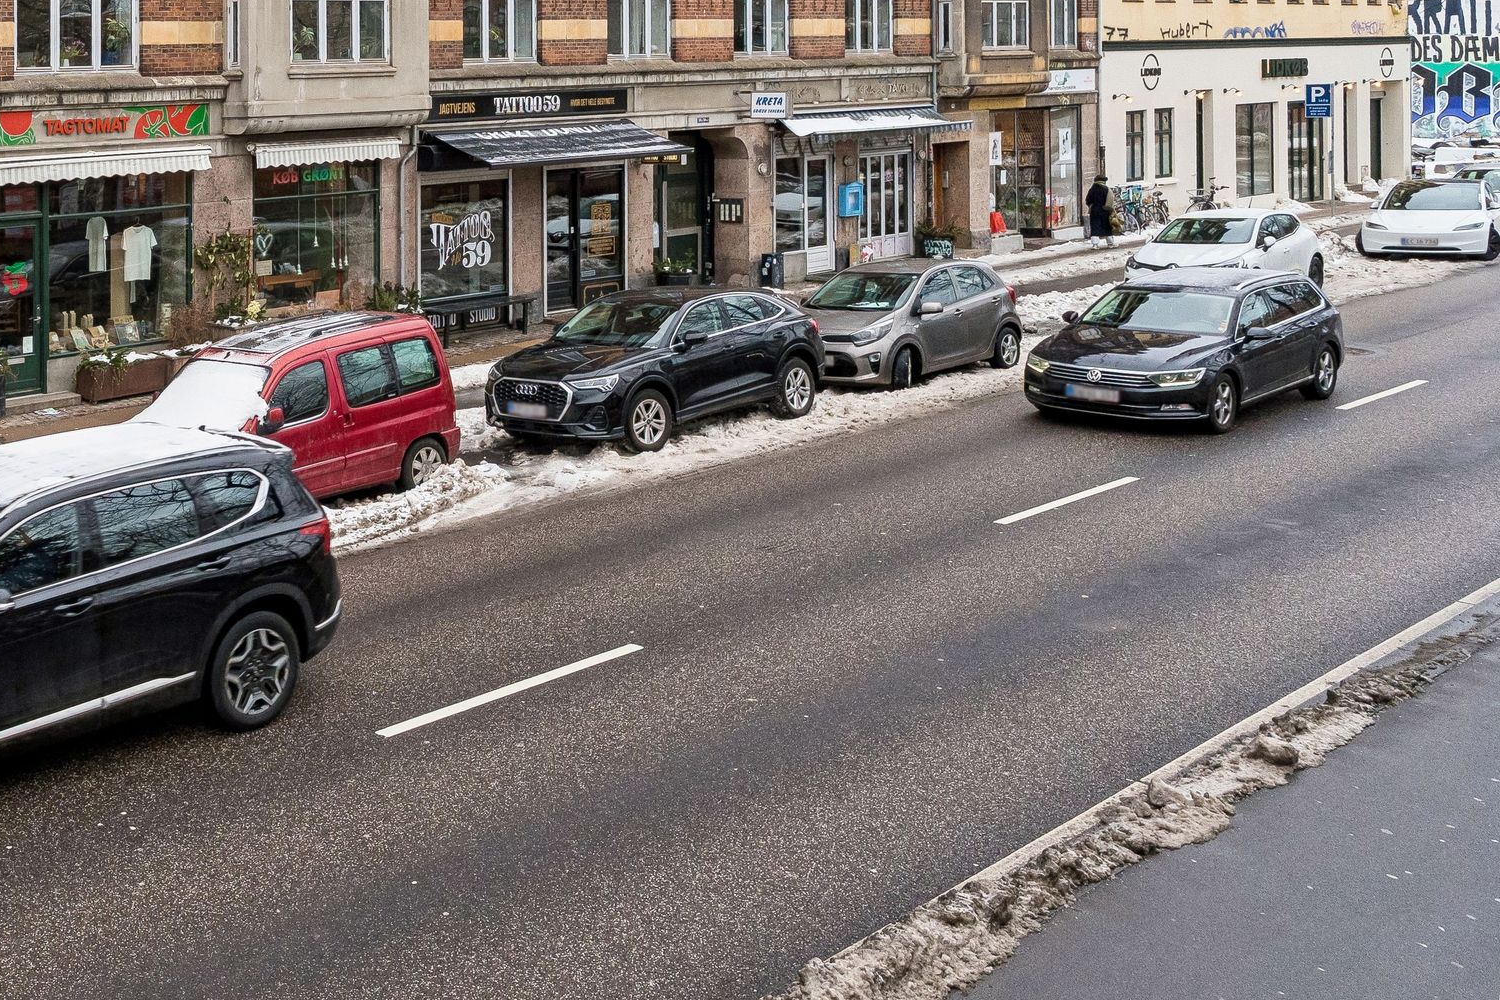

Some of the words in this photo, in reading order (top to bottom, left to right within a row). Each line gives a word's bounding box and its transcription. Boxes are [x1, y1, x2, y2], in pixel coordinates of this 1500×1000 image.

[1262, 58, 1308, 78] LIDKØB
[756, 97, 783, 106] KRETA
[1311, 86, 1325, 103] P
[438, 102, 476, 115] JAGTVEJENS
[43, 116, 130, 137] TAGTOMAT
[273, 170, 299, 185] KØB
[462, 240, 492, 268] 59
